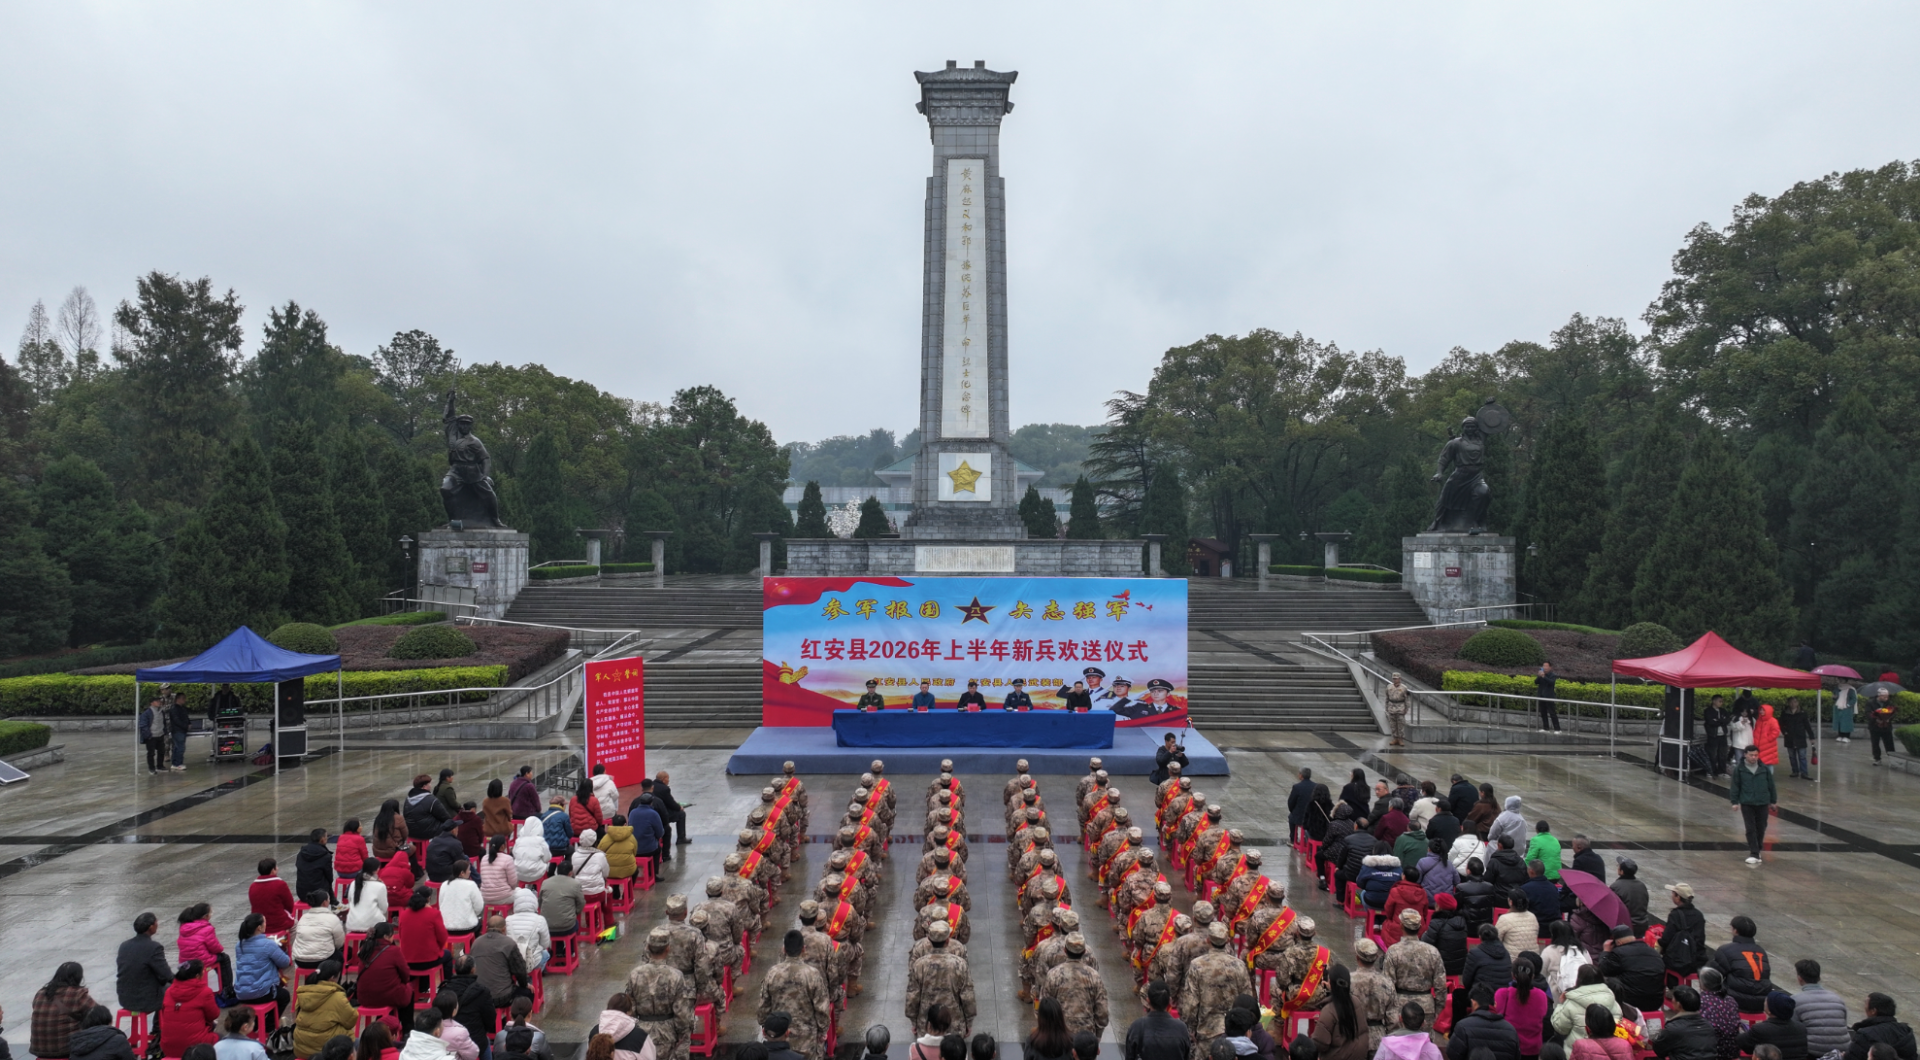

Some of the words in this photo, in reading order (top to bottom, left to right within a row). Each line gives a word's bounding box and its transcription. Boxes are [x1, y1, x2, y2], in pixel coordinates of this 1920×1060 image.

[822, 597, 941, 621] 参军报国
[1008, 599, 1129, 622] 矢志强军
[800, 637, 1148, 663] 红安县2026年上半年新兵欢送仪式
[1741, 951, 1764, 981] V
